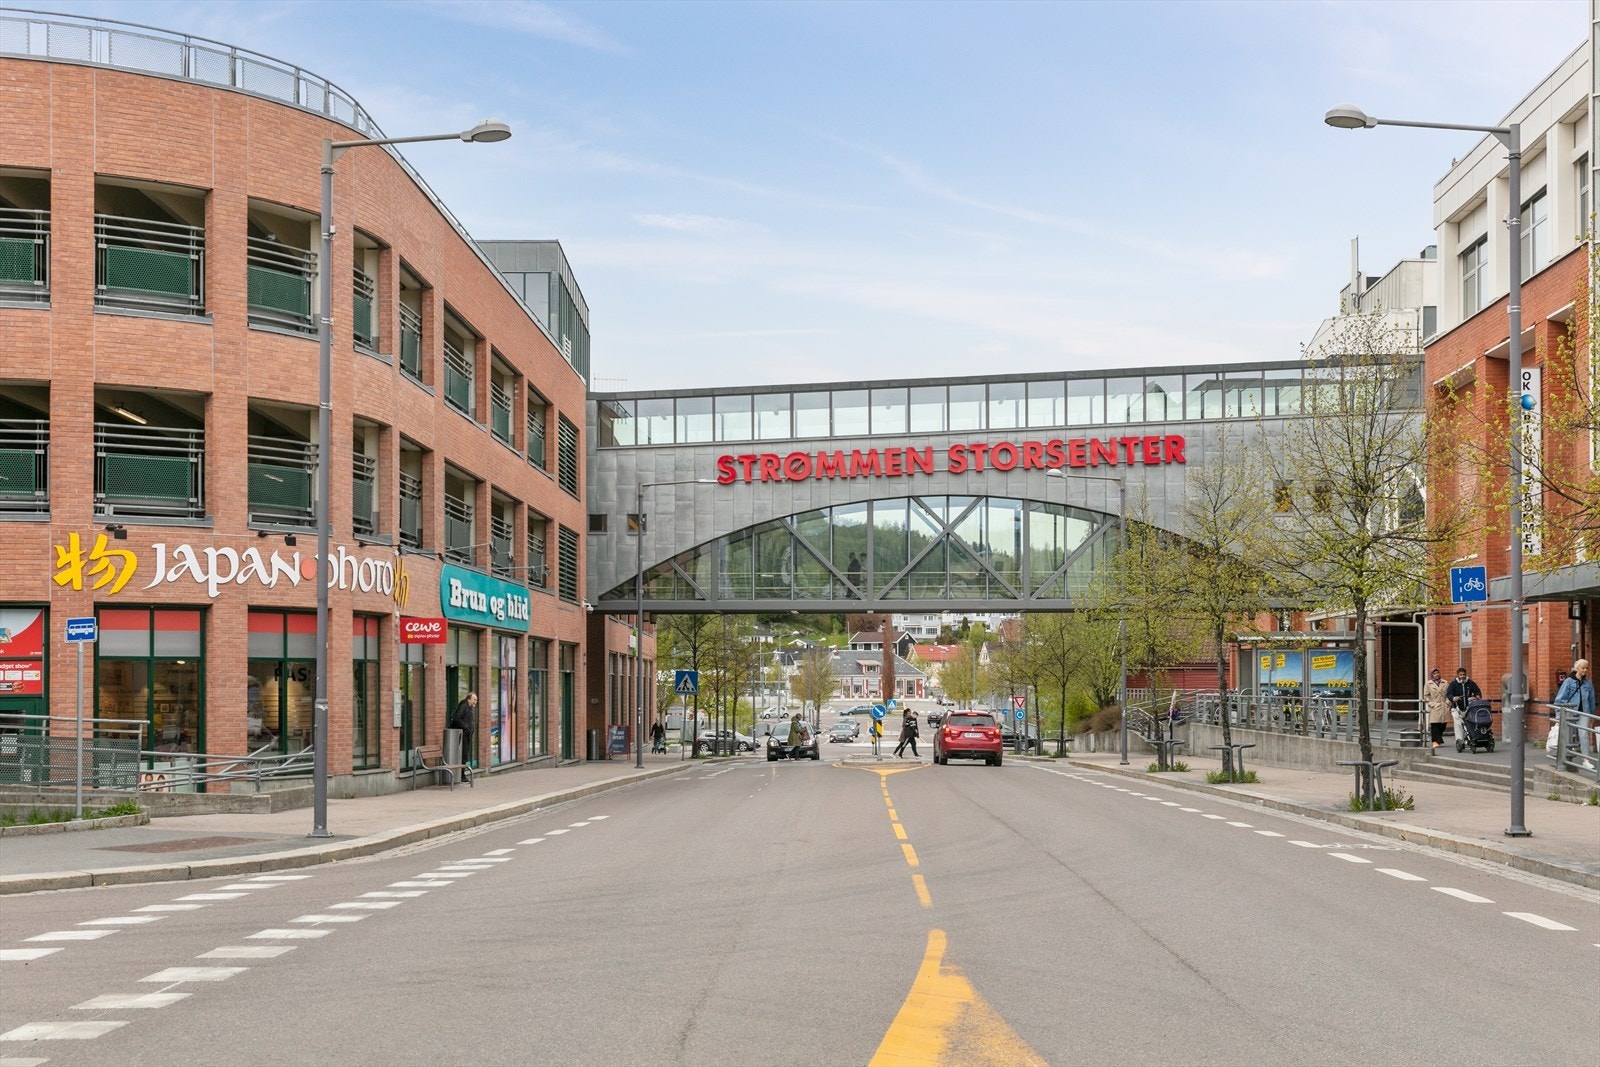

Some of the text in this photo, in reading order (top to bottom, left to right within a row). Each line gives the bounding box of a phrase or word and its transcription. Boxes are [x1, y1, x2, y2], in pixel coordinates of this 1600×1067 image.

[1522, 371, 1532, 391] OK
[716, 434, 1187, 485] STRØMMEN STORSENTER
[53, 531, 139, 596] 物
[450, 578, 529, 621] Brun og blid
[405, 622, 442, 632] cewe
